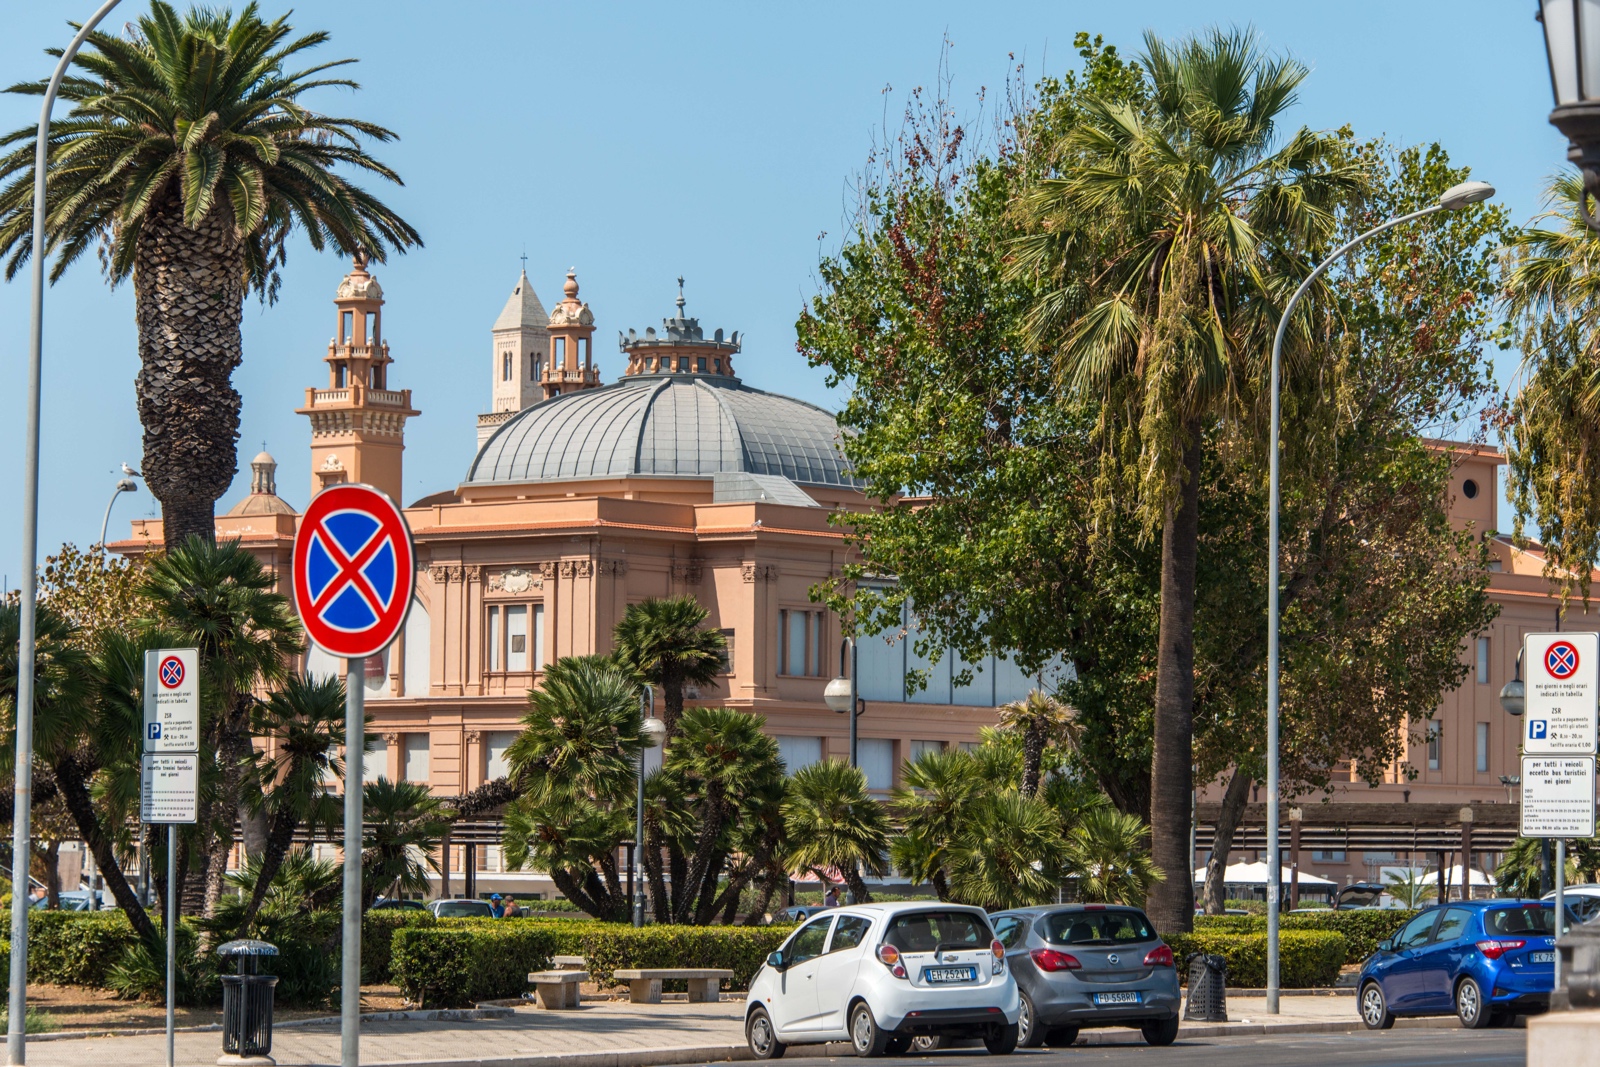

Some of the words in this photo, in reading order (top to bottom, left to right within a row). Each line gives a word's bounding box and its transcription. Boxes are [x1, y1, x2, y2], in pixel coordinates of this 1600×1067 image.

[151, 724, 159, 738] P
[1533, 721, 1545, 738] P
[932, 971, 942, 979] EH
[945, 969, 970, 979] 252VY
[1099, 994, 1109, 1002] FD
[1112, 993, 1135, 1002] 558RD
